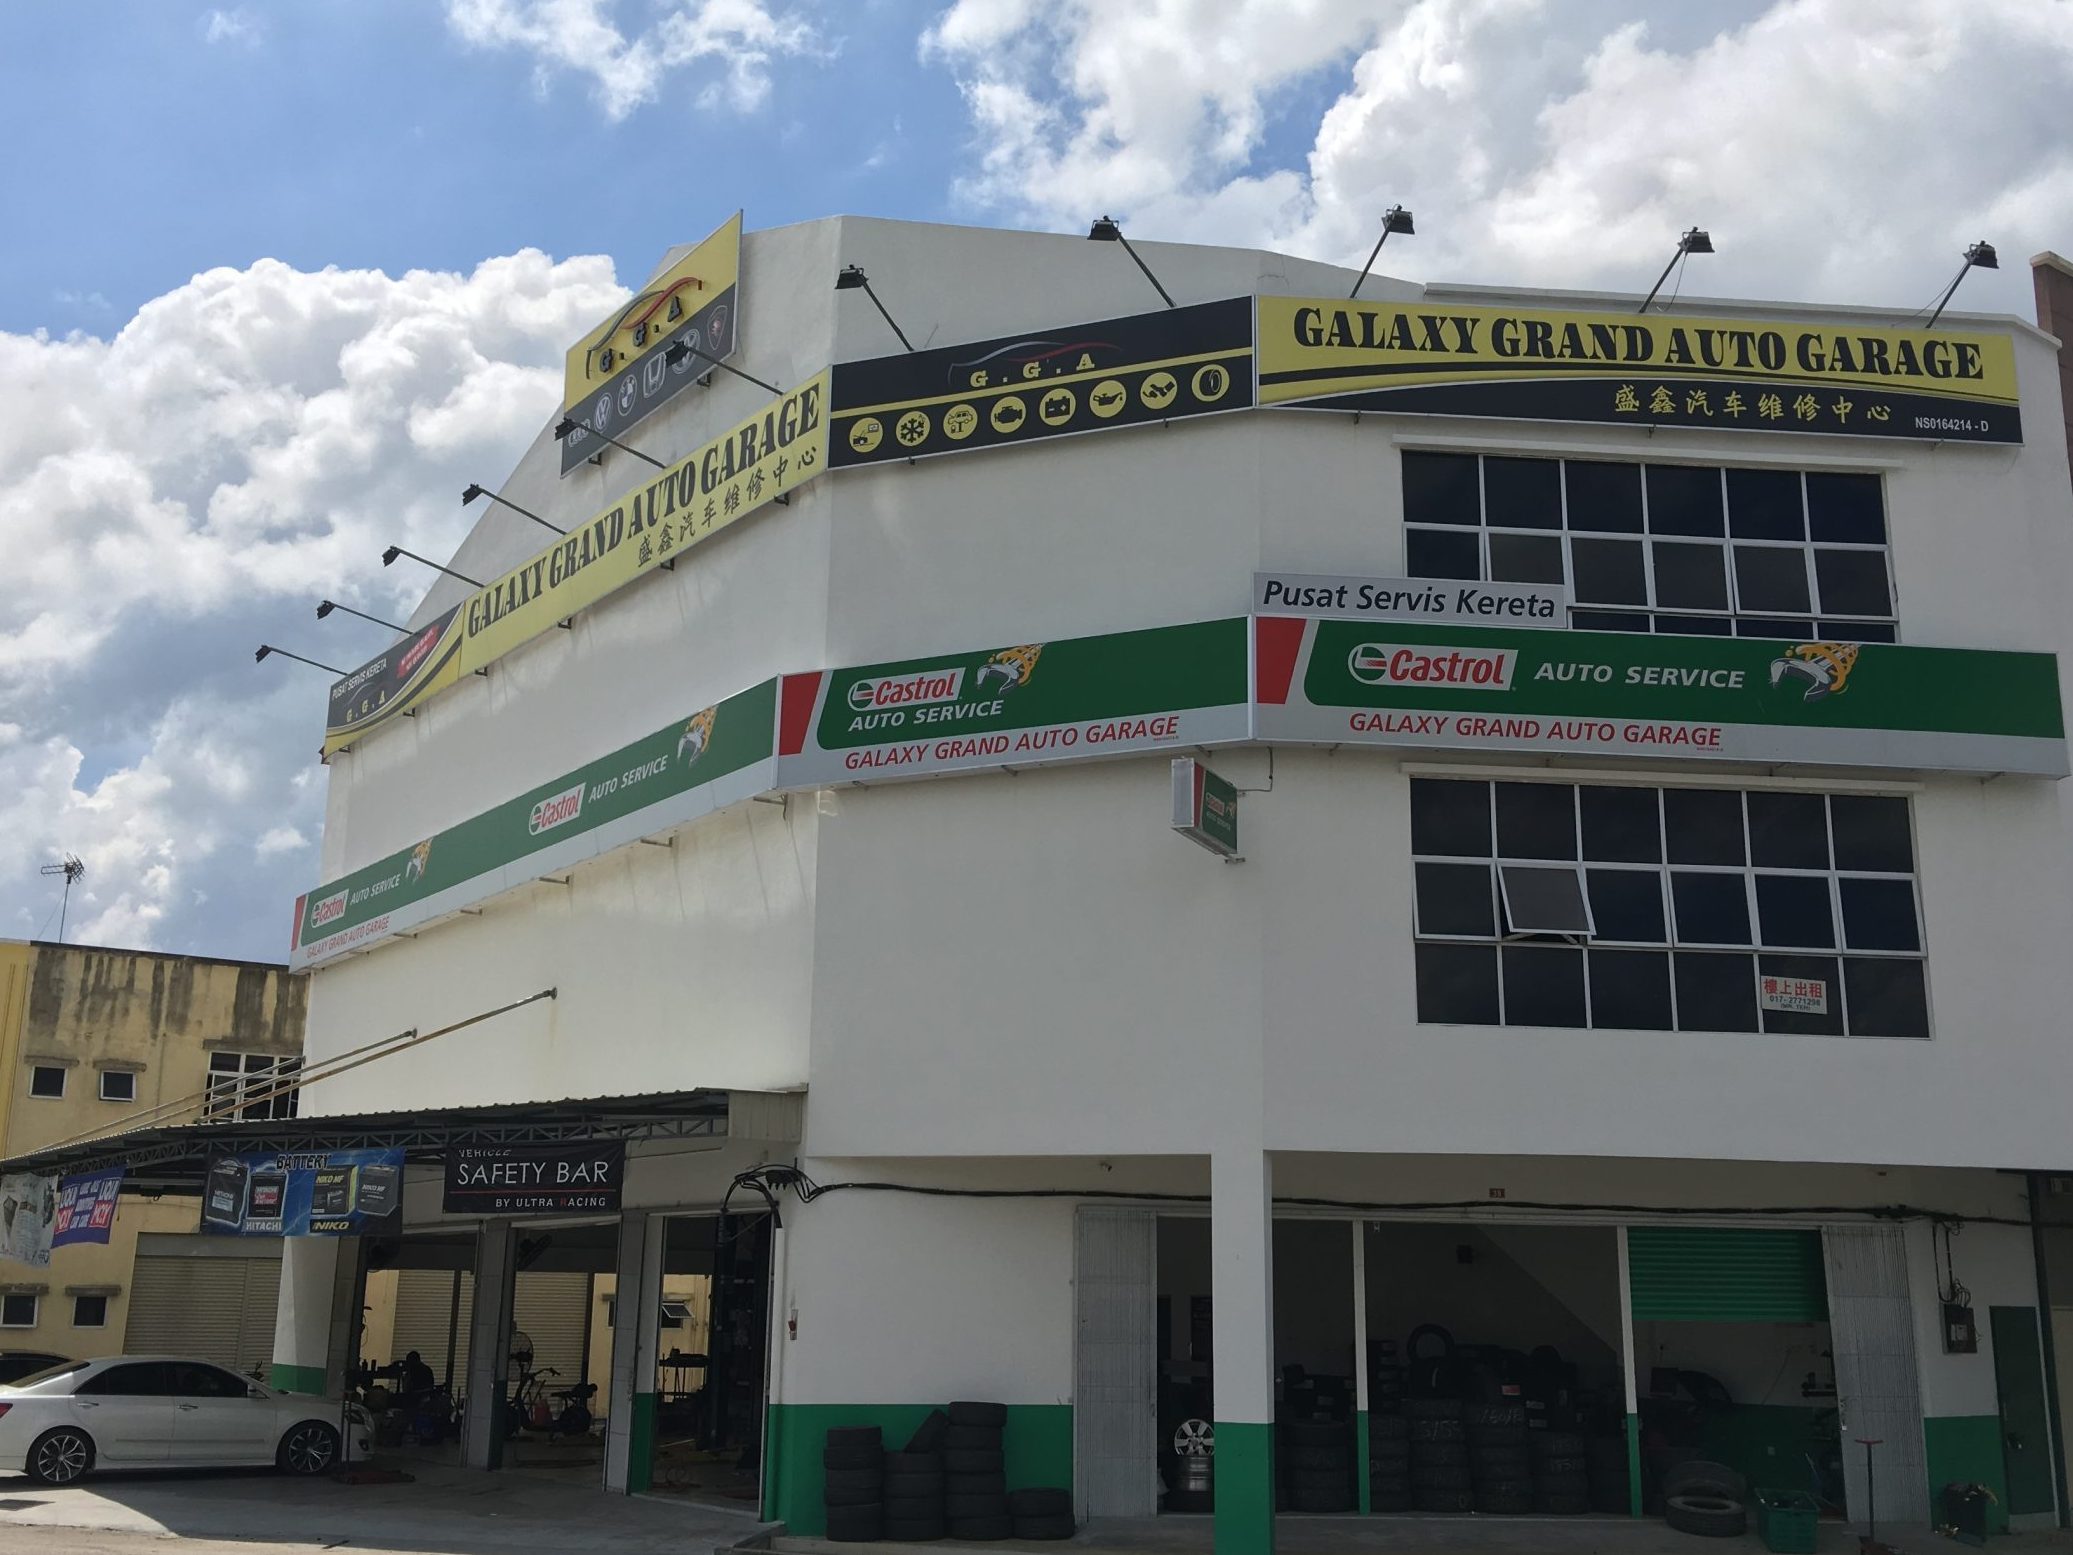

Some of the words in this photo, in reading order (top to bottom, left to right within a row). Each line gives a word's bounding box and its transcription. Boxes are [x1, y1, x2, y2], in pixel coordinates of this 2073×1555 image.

[1294, 308, 1481, 354] GALAXY
[1491, 317, 1654, 362] GRAND
[1664, 327, 1787, 371] AUTO
[1796, 333, 1984, 380] GARAGE
[1614, 384, 1892, 424] 盛鑫汽车维修中心
[469, 556, 547, 639] GALAXY
[550, 506, 624, 589] GRAND
[627, 461, 695, 539] AUTO
[701, 382, 820, 495] GARAGE
[638, 446, 817, 567] 盛鑫汽车维修中心
[1263, 580, 1348, 609] Pusat
[1356, 584, 1446, 613] Servis
[1456, 589, 1555, 618] Kereta
[1390, 650, 1505, 685] Castrol
[1534, 663, 1613, 684] AUTO
[1625, 667, 1746, 689] SERVICE
[875, 672, 956, 706] Castrol
[848, 711, 905, 732] AUTO
[913, 700, 1004, 725] SERVICE
[1349, 712, 1448, 735] GALAXY
[1455, 717, 1540, 739] GRAND
[1547, 721, 1615, 743] AUTO
[1623, 725, 1722, 747] GARAGE
[845, 744, 929, 770] GALAXY
[935, 735, 1010, 760] GRAND
[1016, 727, 1078, 751] AUTO
[1085, 715, 1180, 743] GARAGE
[588, 777, 618, 804] AUTO
[621, 755, 668, 788] SERVICE
[541, 789, 582, 829] Castrol
[350, 891, 369, 906] AUTO
[370, 873, 401, 897] SERVICE
[319, 896, 344, 922] Castrol
[276, 1153, 332, 1170] BATTERY
[457, 1162, 547, 1185] SAFETY
[556, 1161, 609, 1183] BAR
[495, 1198, 510, 1208] BY
[516, 1198, 553, 1207] ULTRA
[559, 1197, 606, 1207] RACING
[246, 1221, 282, 1231] HITACHI
[312, 1221, 350, 1230] NIKO
